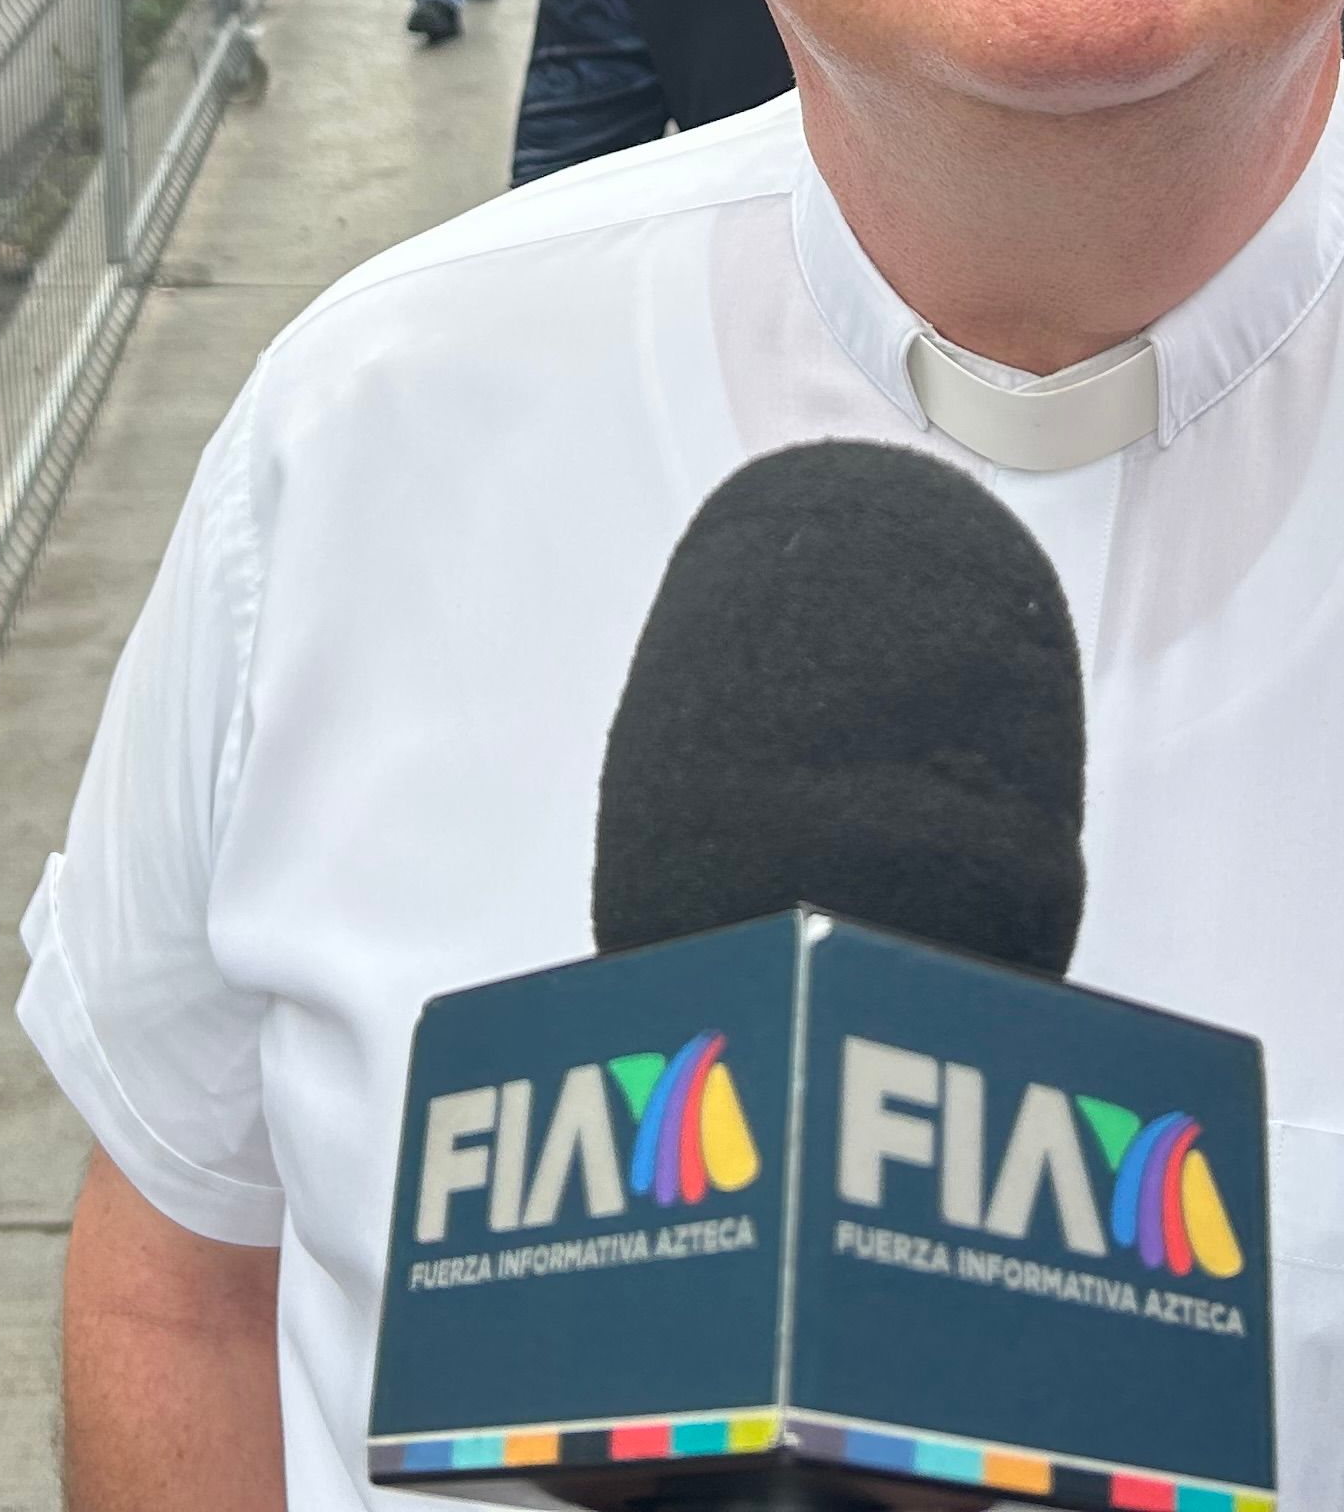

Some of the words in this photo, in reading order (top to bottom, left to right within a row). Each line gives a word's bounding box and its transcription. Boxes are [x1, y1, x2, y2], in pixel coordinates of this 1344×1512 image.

[416, 1062, 626, 1244] FIA
[837, 1035, 1106, 1257] FIA
[410, 1253, 493, 1290] FUERZA
[497, 1230, 649, 1281] INFORMATIVA
[655, 1215, 755, 1259] AZTECA
[836, 1220, 949, 1274] FUERZA
[958, 1248, 1136, 1314] INFORMATIVA
[1144, 1291, 1246, 1336] AZTECA
